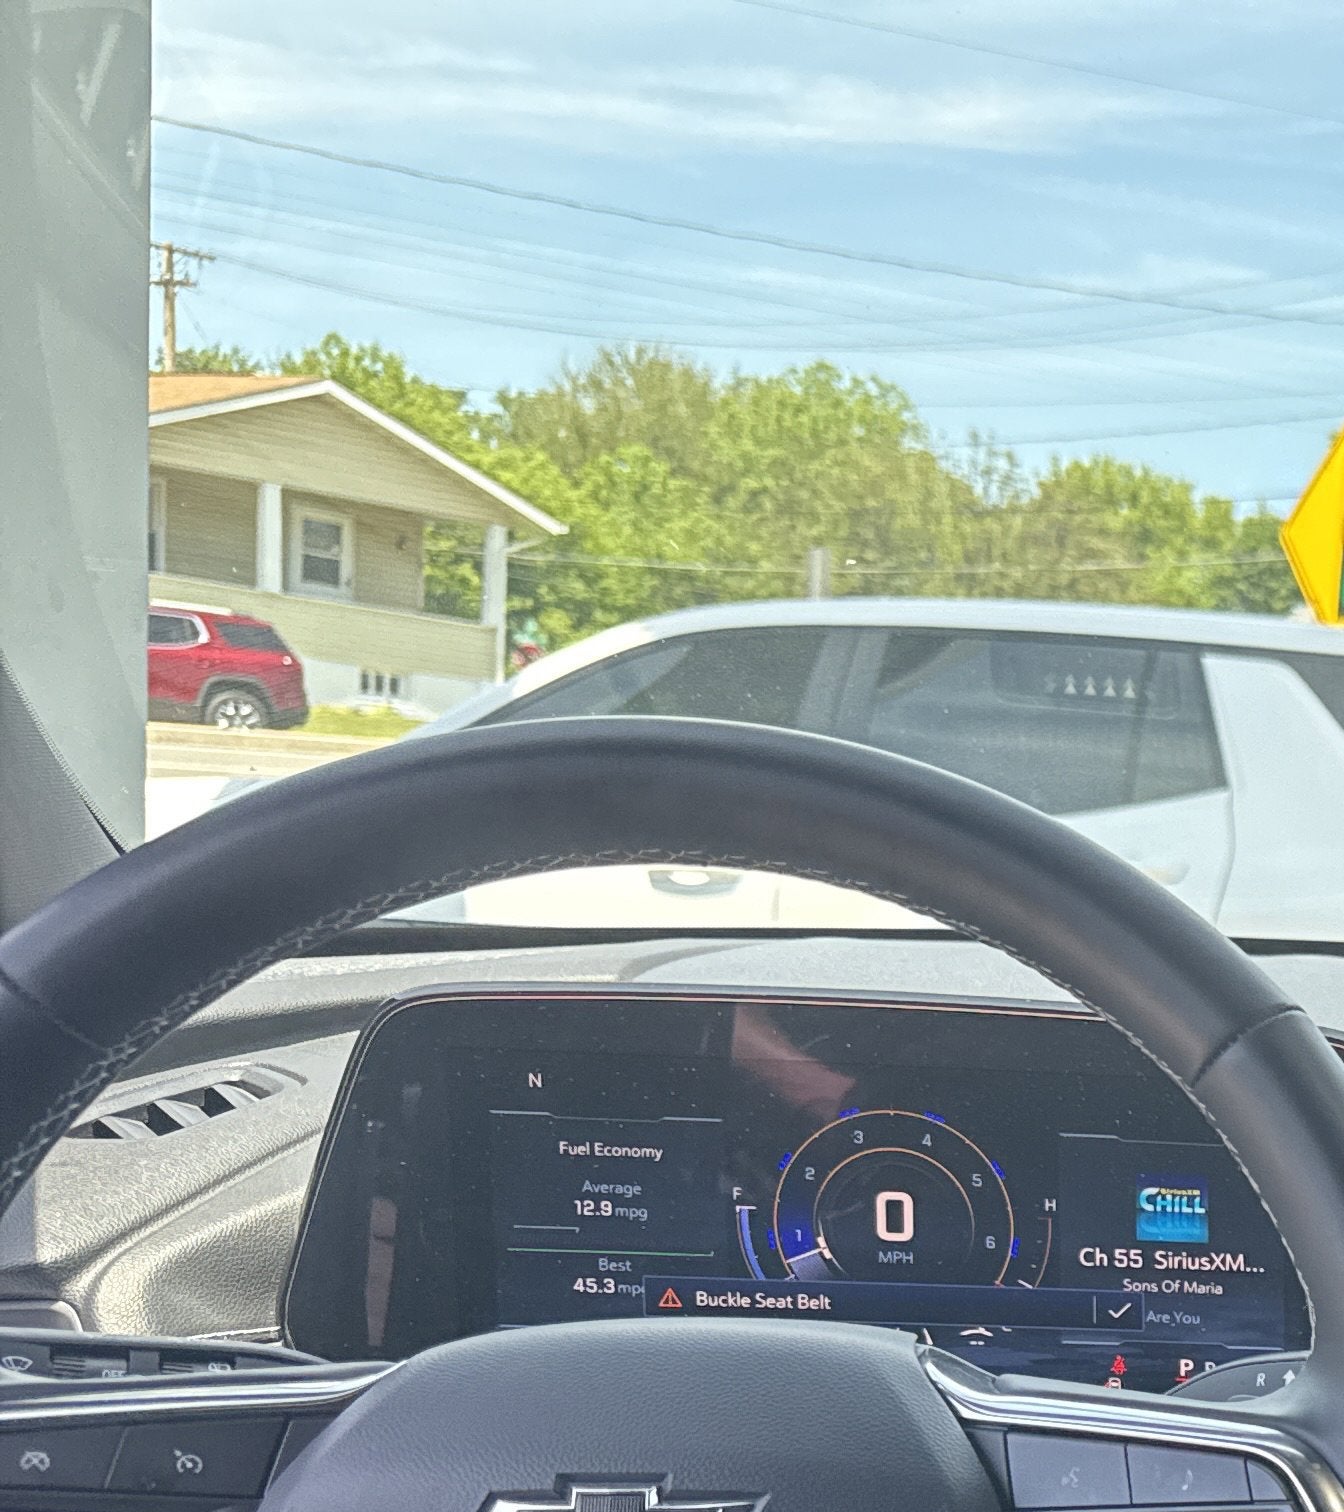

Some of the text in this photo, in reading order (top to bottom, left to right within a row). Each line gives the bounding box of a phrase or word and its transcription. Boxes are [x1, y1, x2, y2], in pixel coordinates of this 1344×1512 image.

[528, 1073, 543, 1089] N
[854, 1130, 864, 1145] 3
[922, 1133, 932, 1147] 4
[559, 1141, 663, 1161] Fuel Economy
[805, 1167, 815, 1181] 2
[972, 1173, 982, 1188] 5
[582, 1180, 642, 1198] Average
[732, 1187, 742, 1200] F
[1044, 1199, 1057, 1212] H
[1138, 1187, 1206, 1214] CHILL
[574, 1200, 648, 1222] 12.9 mpg
[876, 1191, 914, 1242] 0
[795, 1229, 802, 1242] 1
[985, 1236, 996, 1250] 6
[598, 1258, 632, 1272] Best
[878, 1251, 914, 1264] MPH
[1079, 1248, 1265, 1273] Ch 55 SiriusXM...
[573, 1278, 615, 1294] 45.3
[1123, 1278, 1223, 1295] Sons Of Maria
[696, 1291, 832, 1310] Buckle Seat Belt
[1146, 1311, 1200, 1325] Are You
[1179, 1359, 1194, 1377] P
[1256, 1373, 1266, 1387] R
